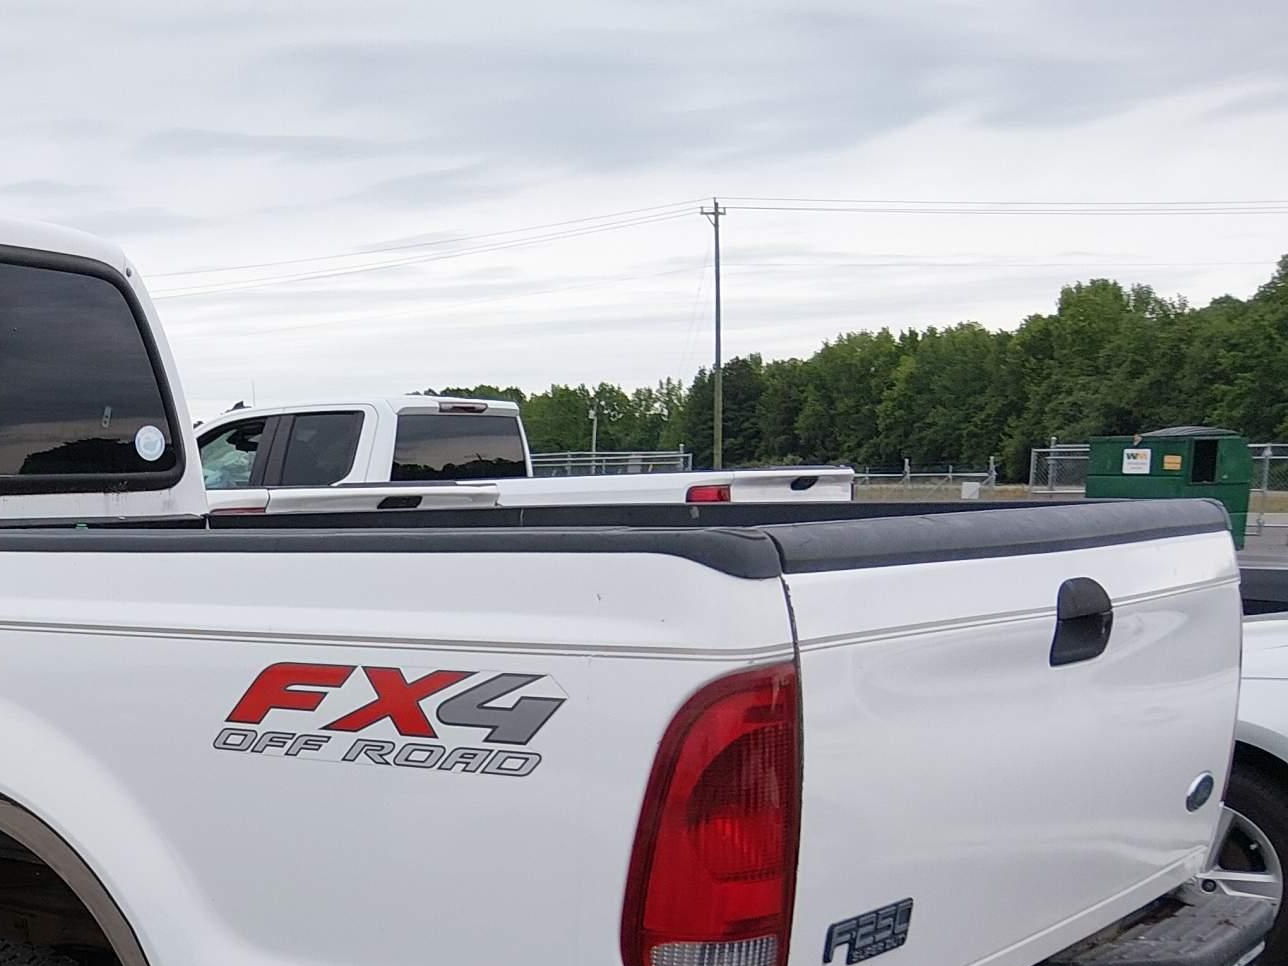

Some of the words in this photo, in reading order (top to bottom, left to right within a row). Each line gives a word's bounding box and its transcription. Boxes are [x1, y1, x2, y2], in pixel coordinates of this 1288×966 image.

[225, 661, 569, 746] FX4
[212, 727, 332, 757] OFF
[341, 738, 543, 778] ROAD
[825, 898, 913, 962] F250
